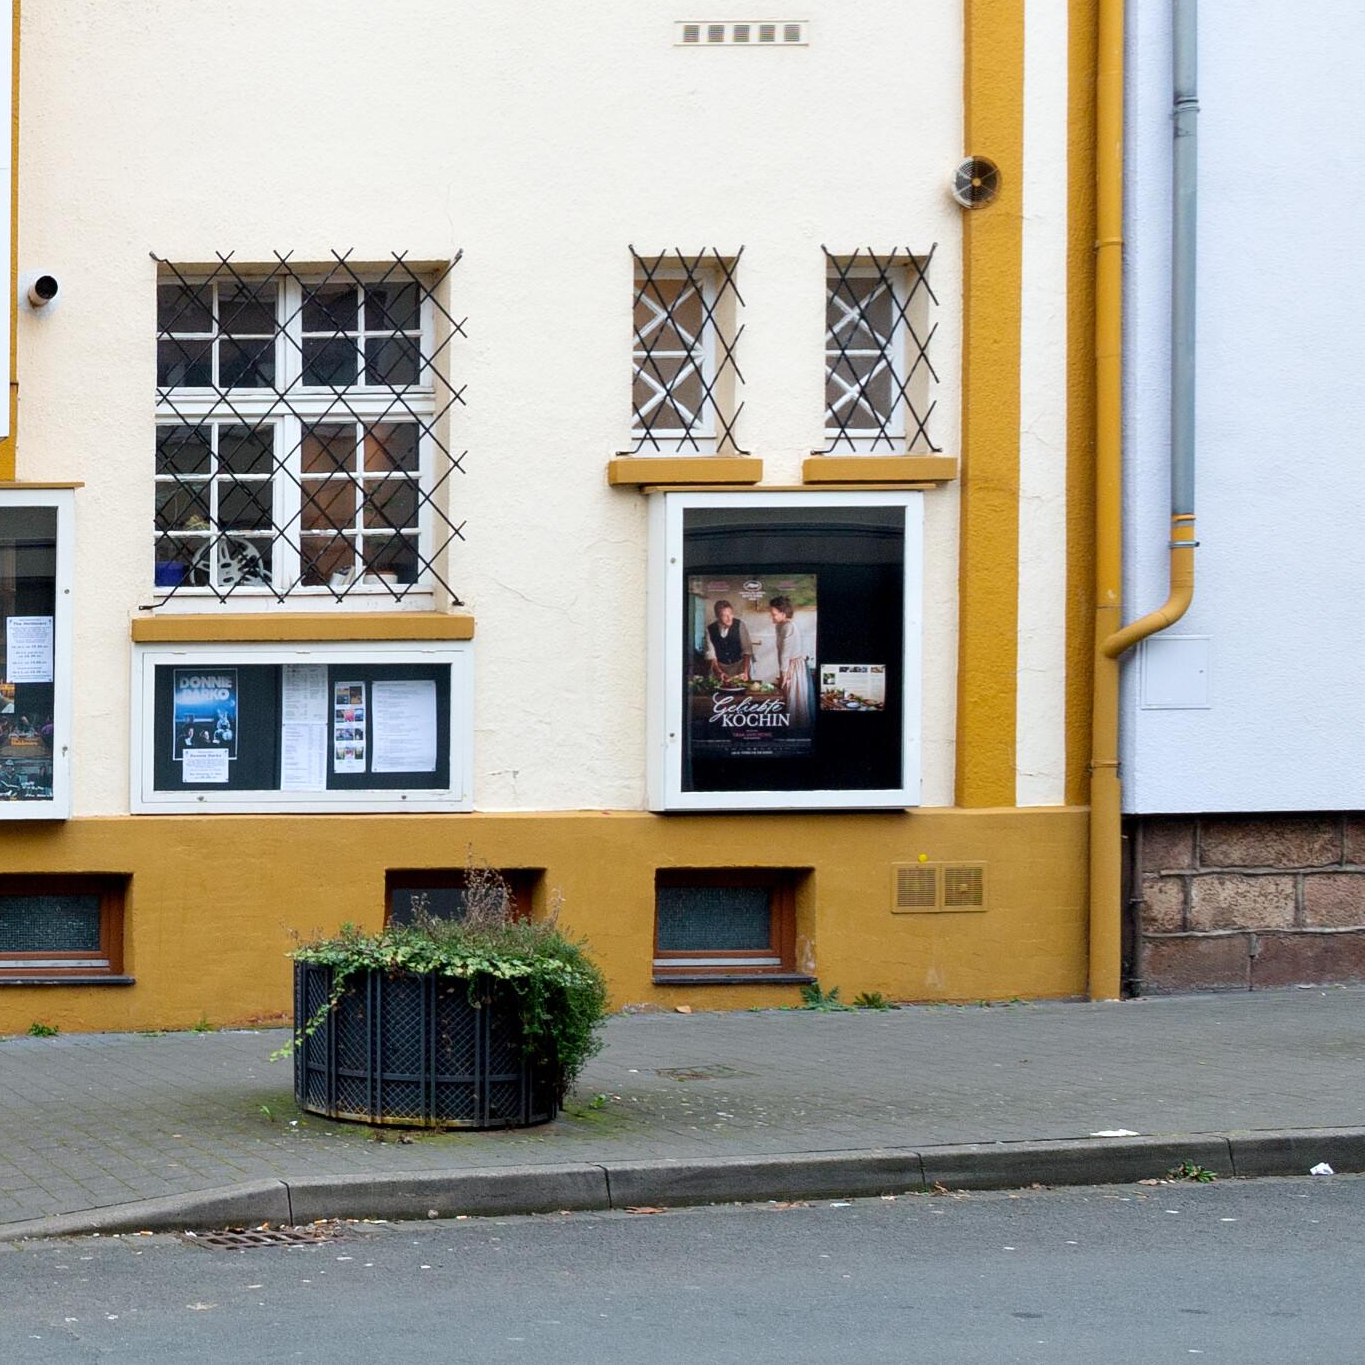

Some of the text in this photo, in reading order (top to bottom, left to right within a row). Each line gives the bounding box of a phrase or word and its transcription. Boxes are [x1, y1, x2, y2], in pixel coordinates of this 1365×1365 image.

[180, 676, 232, 688] DONNIE
[709, 692, 786, 722] Geliebte
[722, 710, 790, 727] KÖCHIN
